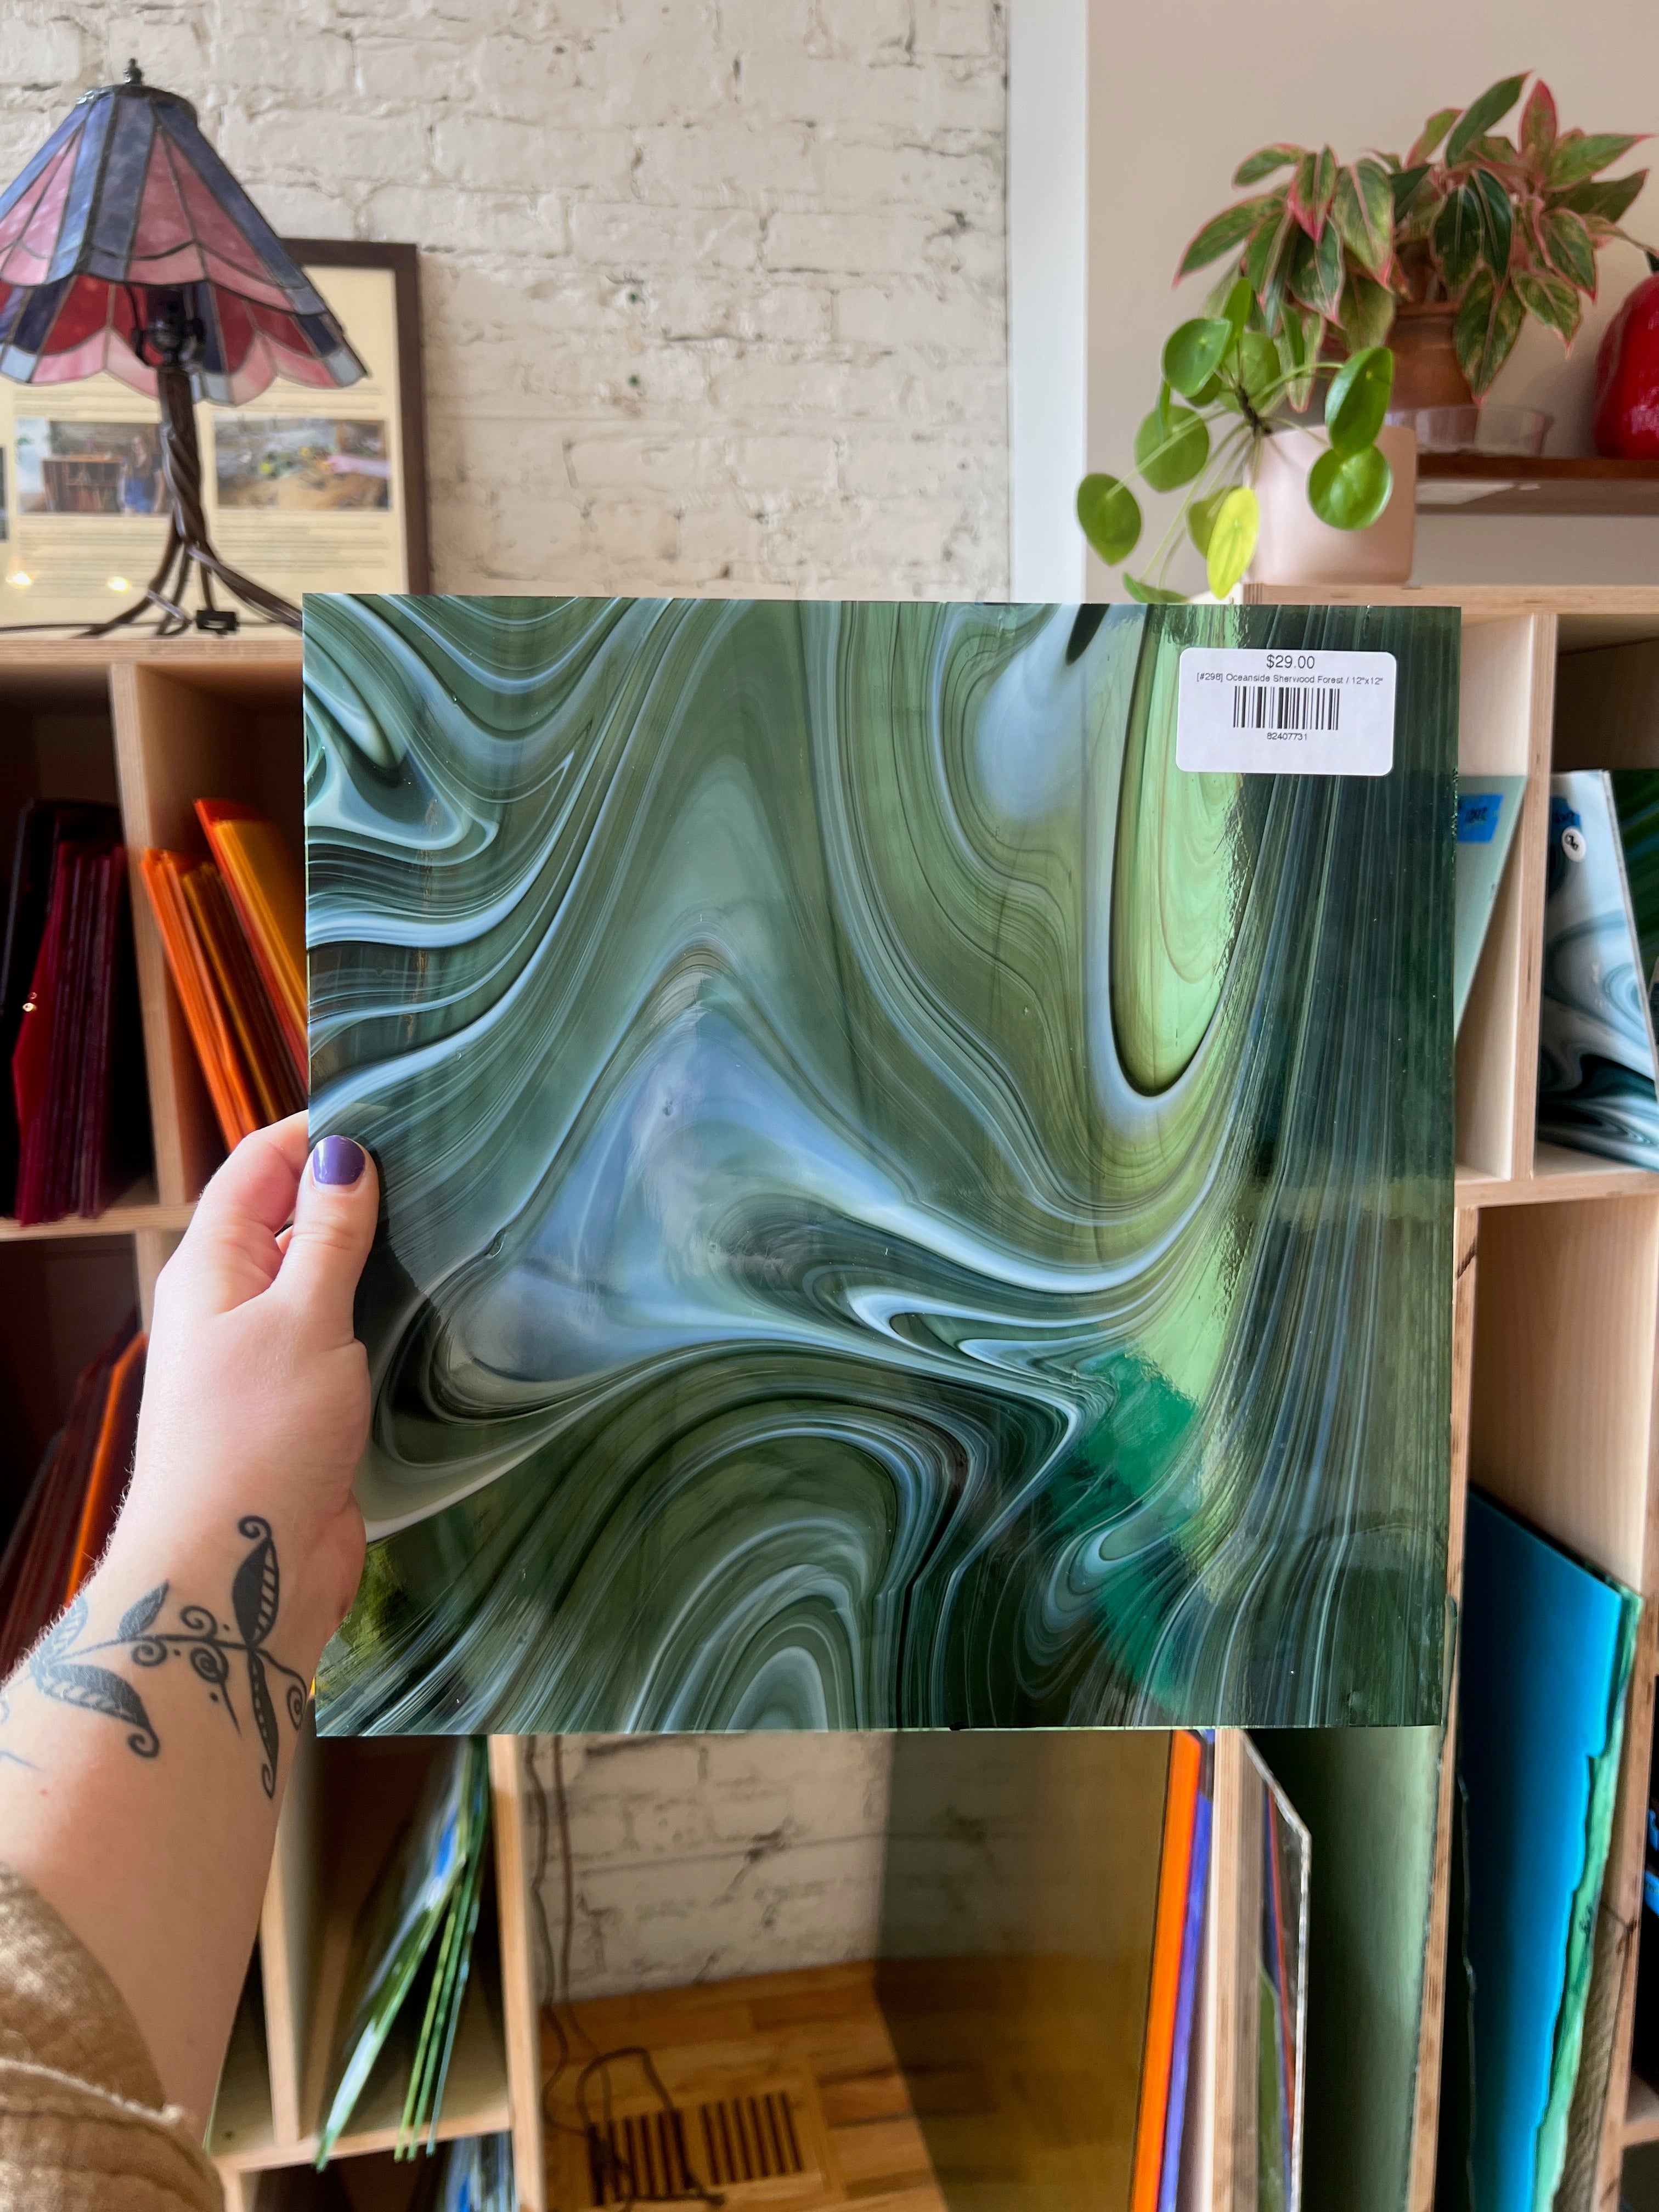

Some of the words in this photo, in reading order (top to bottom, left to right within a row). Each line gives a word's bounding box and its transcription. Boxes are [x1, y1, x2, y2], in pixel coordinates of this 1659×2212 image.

[1266, 654, 1315, 669] $29.00
[1197, 673, 1223, 682] [#298]
[1226, 673, 1270, 682] Oceanside
[1273, 675, 1315, 684] Sherwood
[1317, 675, 1344, 684] Forest
[1267, 732, 1307, 741] 82407731
